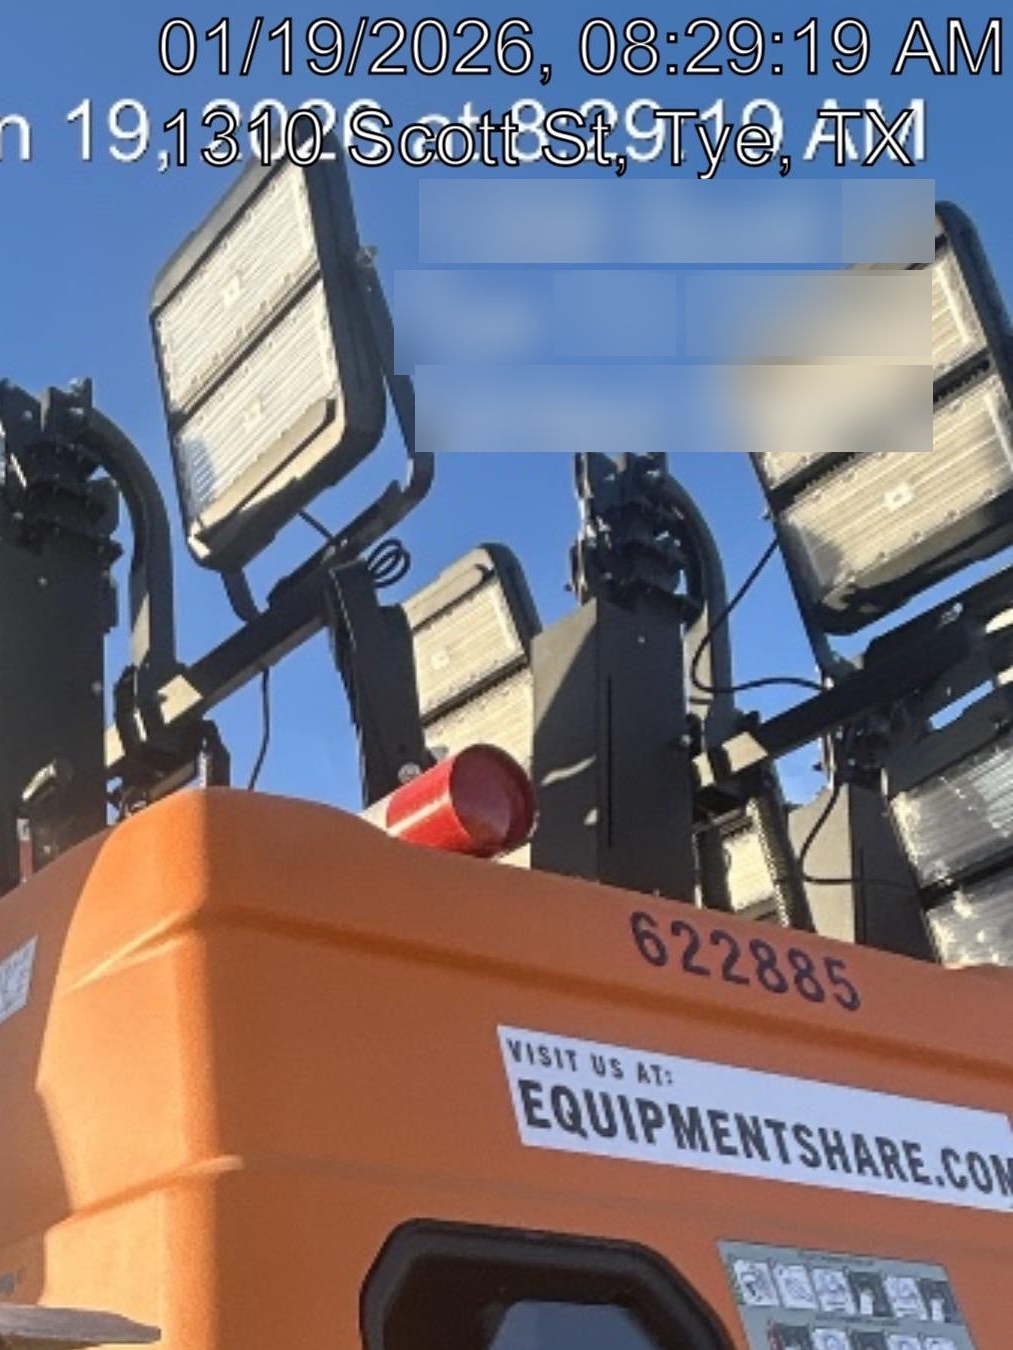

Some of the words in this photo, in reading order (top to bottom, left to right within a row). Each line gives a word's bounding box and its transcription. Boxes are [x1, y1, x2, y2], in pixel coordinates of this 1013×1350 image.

[629, 910, 862, 1012] 622885
[506, 1038, 578, 1072] VISIT
[590, 1052, 625, 1080] US
[637, 1061, 675, 1086] AT:
[518, 1078, 1013, 1197] EQUIPMENTSHARE.COM
